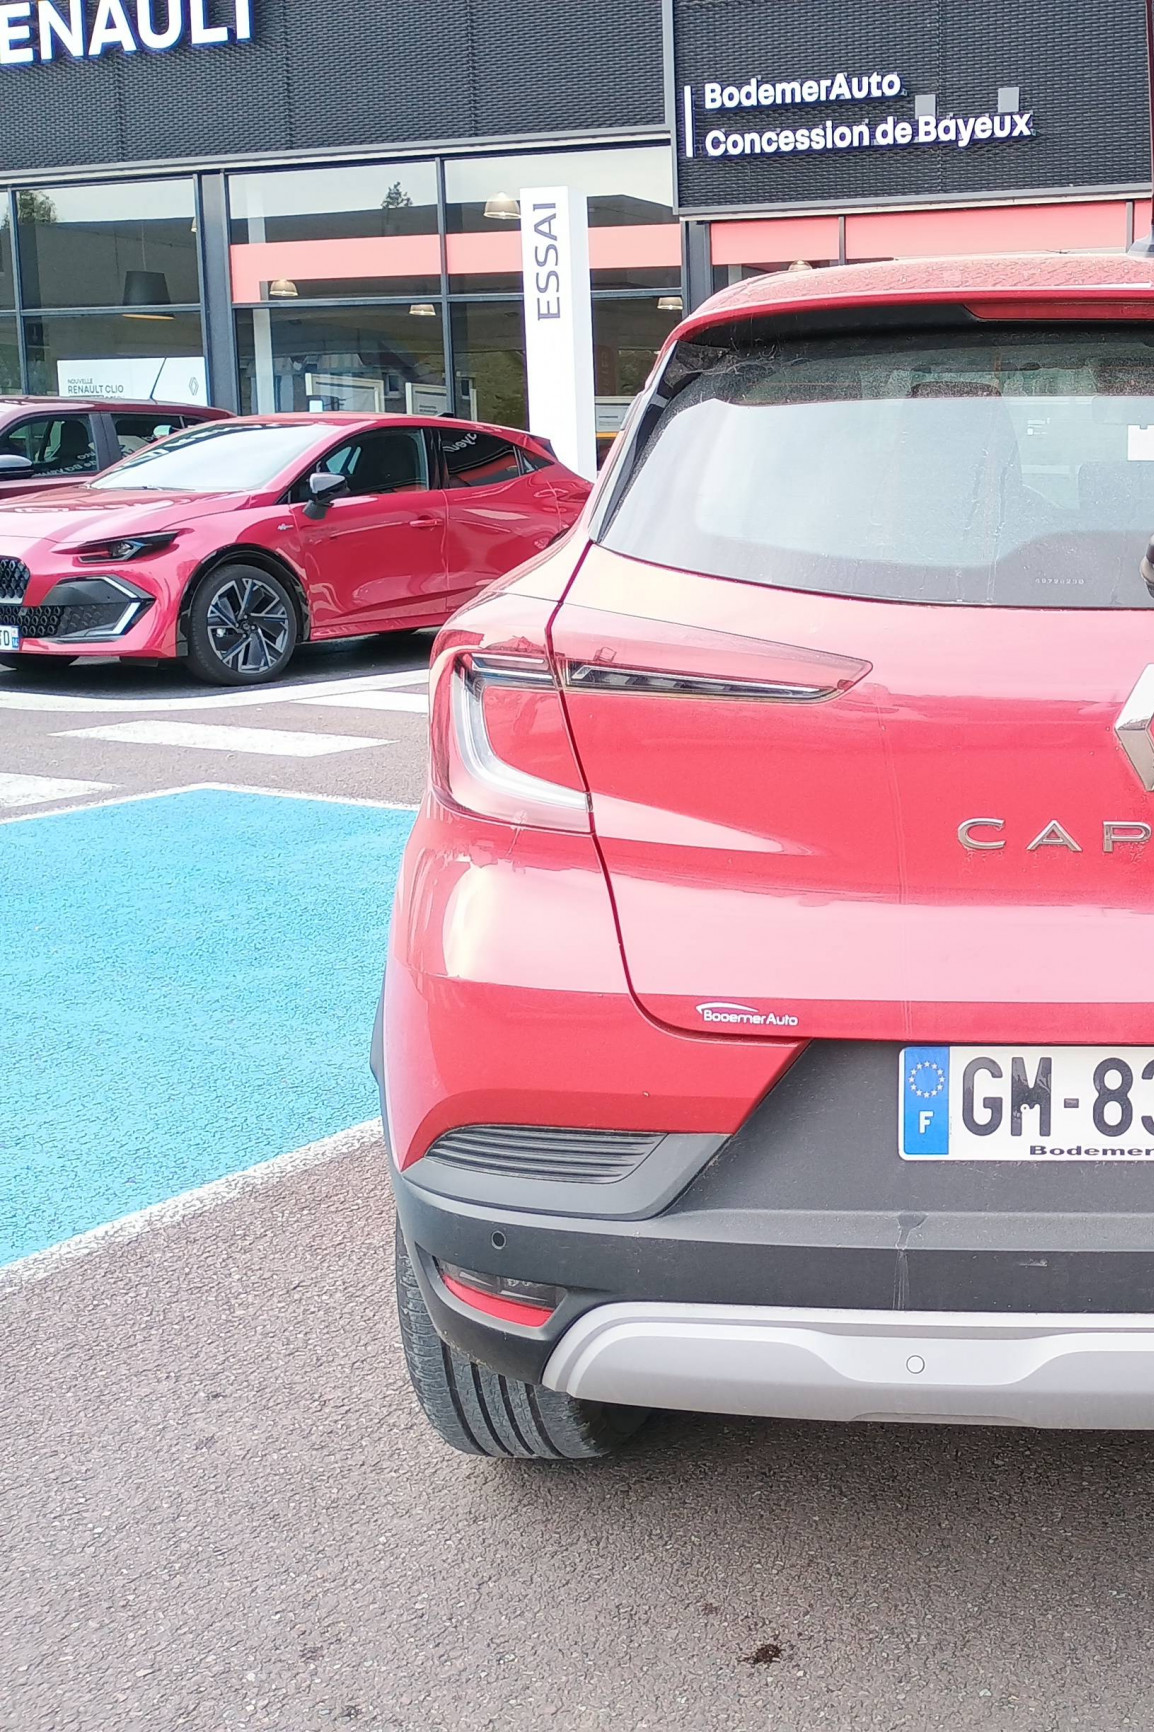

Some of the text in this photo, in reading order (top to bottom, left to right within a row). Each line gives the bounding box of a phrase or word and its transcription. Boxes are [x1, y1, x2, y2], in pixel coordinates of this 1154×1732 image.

[704, 72, 902, 109] BodemerAuto
[704, 112, 1033, 156] Concession de Bayeux
[532, 203, 561, 320] ESSAI
[67, 384, 124, 394] RENAULT CLIO
[919, 1110, 934, 1134] F
